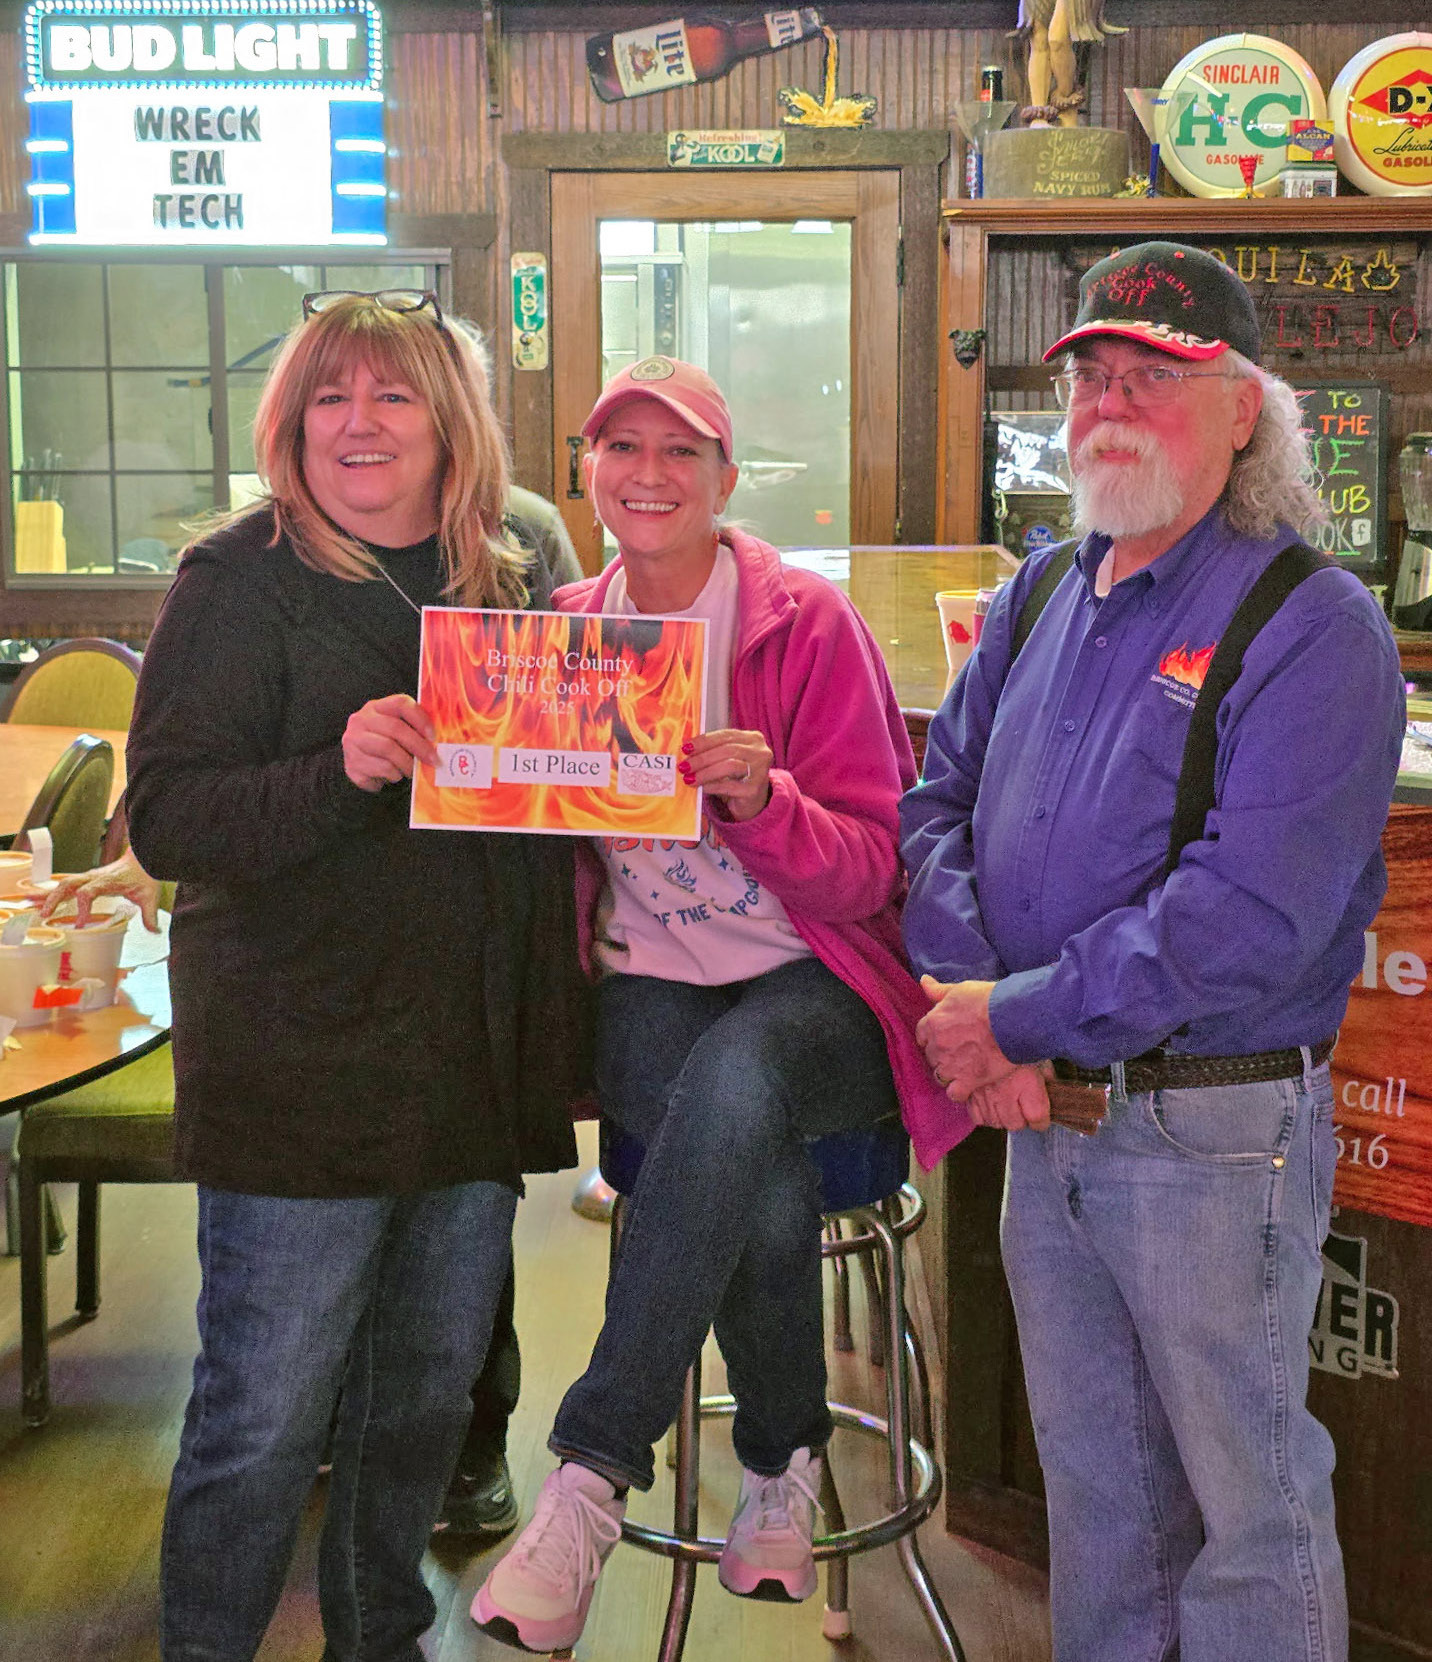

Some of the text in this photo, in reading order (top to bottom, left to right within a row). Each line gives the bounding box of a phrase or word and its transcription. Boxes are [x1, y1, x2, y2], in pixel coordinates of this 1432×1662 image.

[50, 23, 357, 72] BUD LIGHT
[656, 30, 685, 76] Lite
[1203, 64, 1280, 85] SINCLAIR
[1388, 86, 1432, 114] D-
[136, 106, 261, 142] WRECK
[707, 145, 756, 163] KOOL
[1206, 153, 1265, 165] GASOE
[1382, 156, 1432, 168] GASOL
[171, 150, 224, 186] EM
[1049, 171, 1101, 182] SPICED
[1032, 182, 1112, 196] NAVY RUM
[154, 194, 244, 230] TECH
[520, 276, 538, 331] KOOL
[1107, 288, 1150, 307] Off
[1274, 304, 1418, 348] LEJO
[1327, 390, 1362, 409] TO
[1317, 414, 1373, 436] THE
[487, 649, 634, 677] Briscoe County
[487, 674, 632, 697] Chili Cook Off
[540, 700, 576, 715] 2025
[512, 754, 600, 776] 1st Place
[622, 754, 672, 769] CASI
[676, 903, 711, 926] THE
[1361, 931, 1428, 997] le
[1341, 1076, 1407, 1118] call
[1312, 1277, 1394, 1362] ER
[1307, 1335, 1358, 1373] NG
